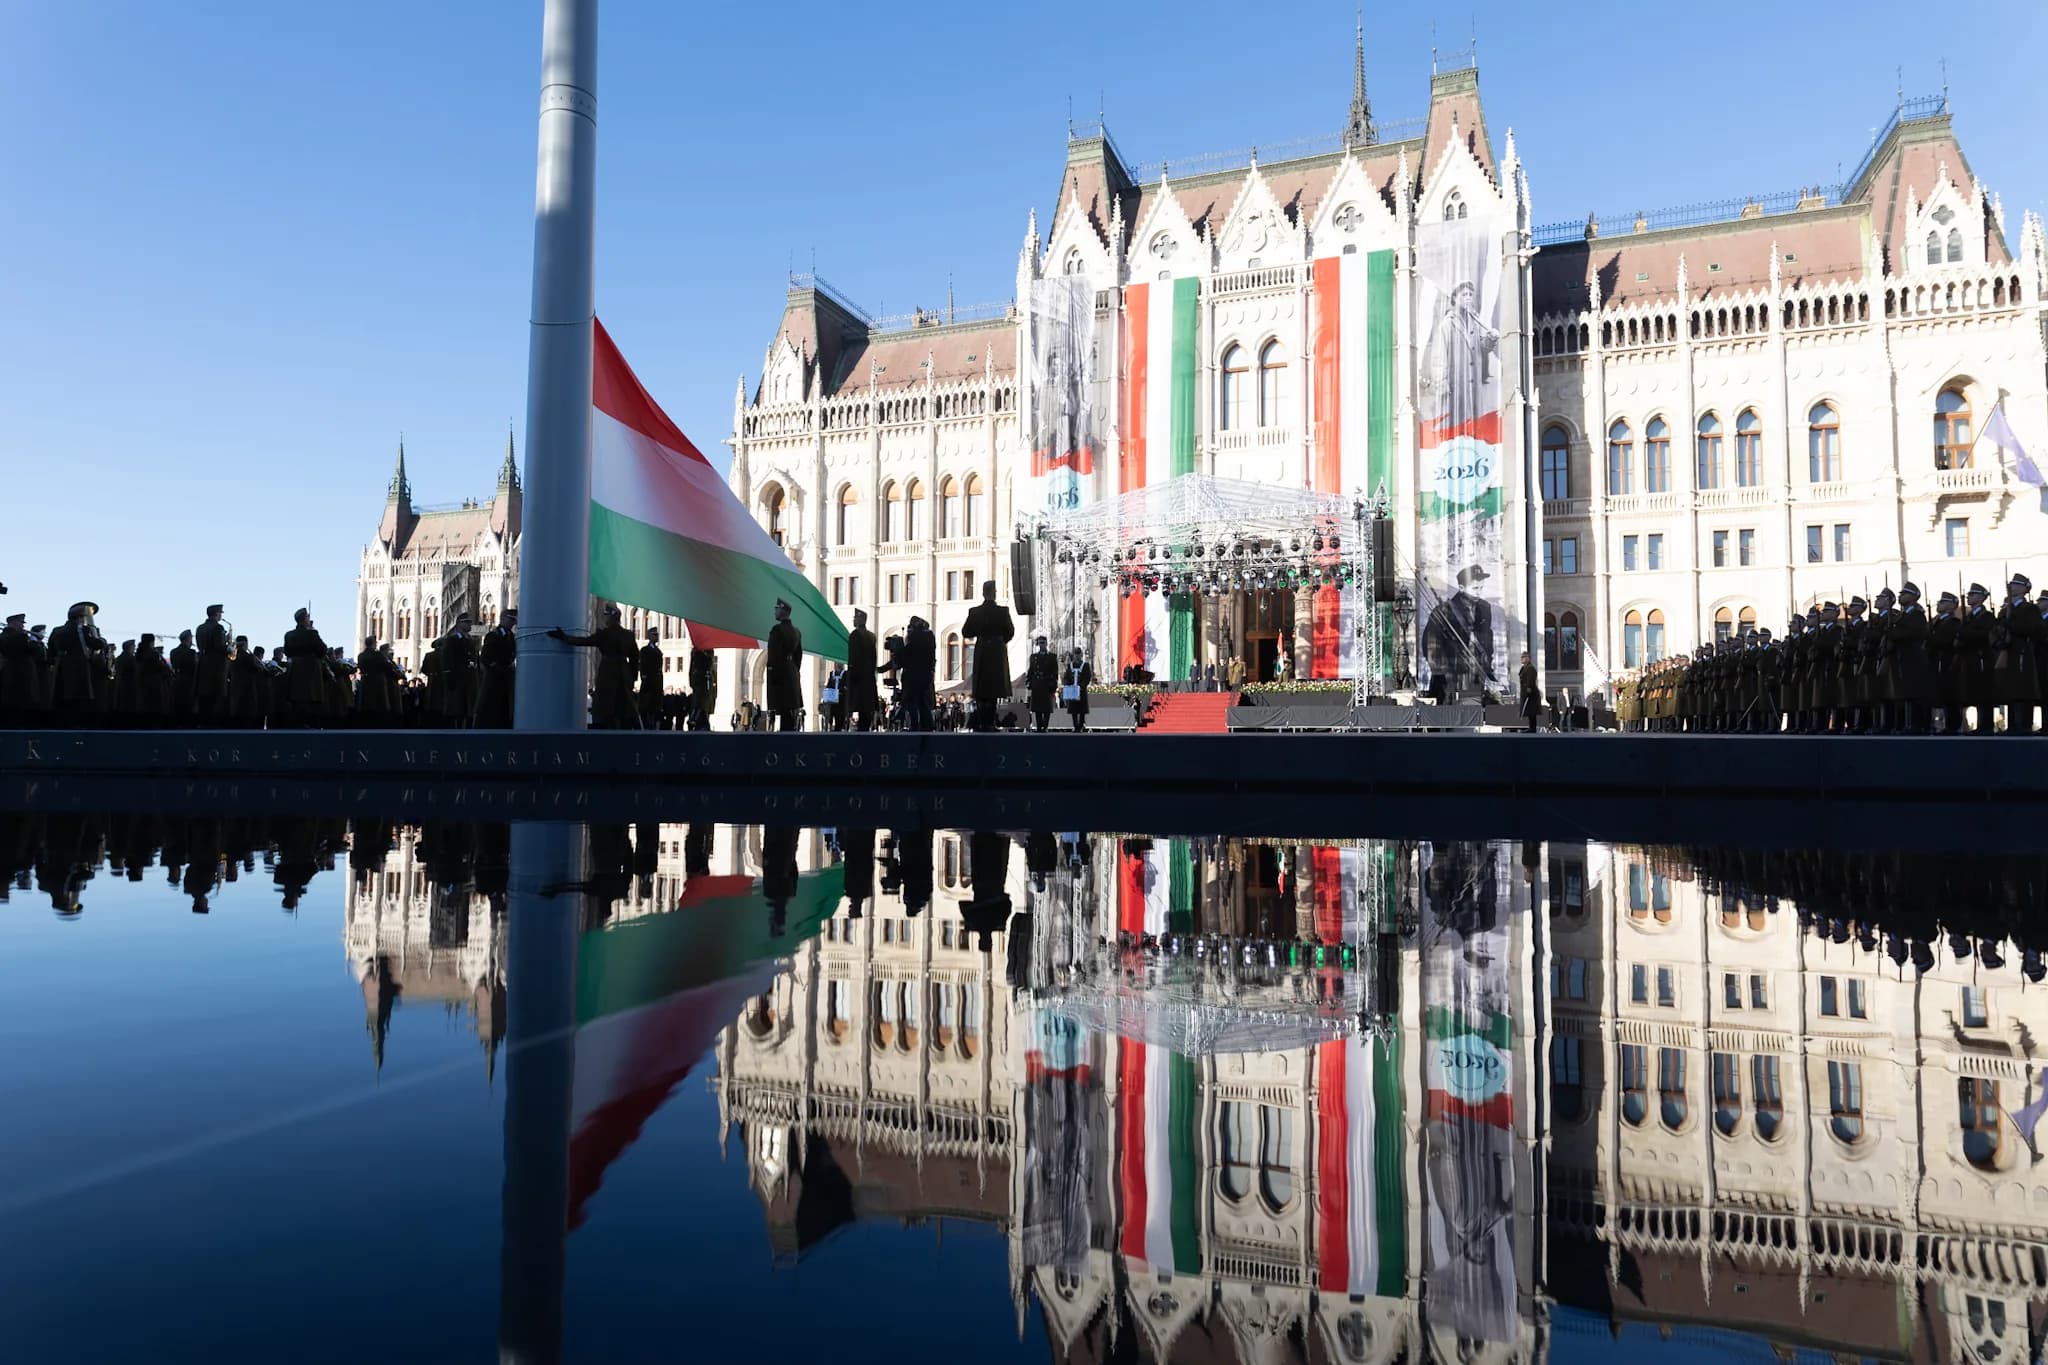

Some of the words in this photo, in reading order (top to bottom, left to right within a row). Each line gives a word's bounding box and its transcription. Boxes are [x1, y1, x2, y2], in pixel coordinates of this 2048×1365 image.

[1433, 458, 1489, 480] 2026
[1047, 486, 1079, 510] 1956
[188, 749, 240, 762] KOR
[339, 750, 369, 763] IN
[402, 750, 592, 766] MEMORIAM
[634, 752, 725, 767] 1956.
